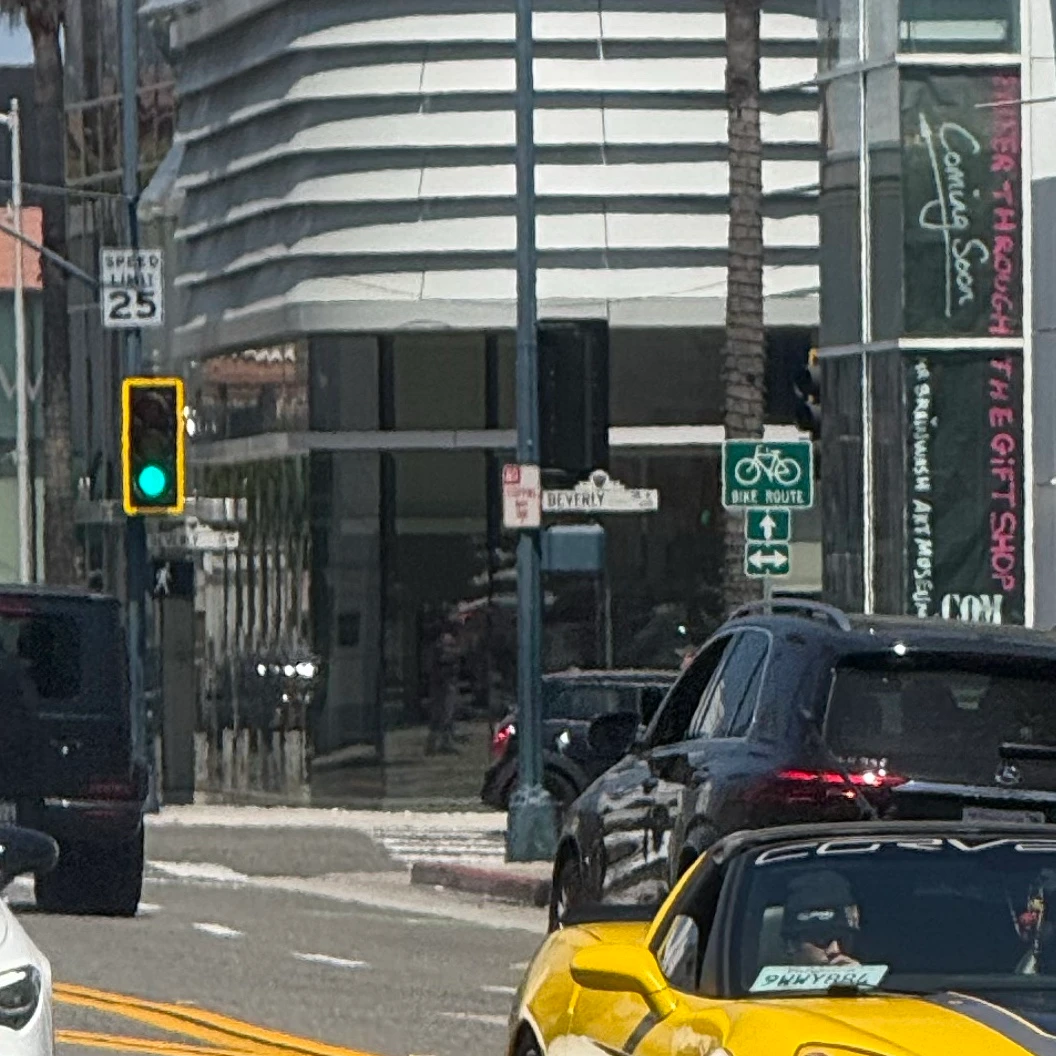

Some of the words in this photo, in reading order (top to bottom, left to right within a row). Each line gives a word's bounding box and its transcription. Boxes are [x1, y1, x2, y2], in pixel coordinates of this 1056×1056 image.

[919, 122, 981, 229] Coming
[952, 239, 989, 305] Soon
[105, 254, 158, 268] SPEED
[989, 180, 1017, 334] THROUGH
[111, 273, 153, 286] LIMIT
[109, 290, 156, 318] 25
[988, 358, 1013, 427] THE
[547, 492, 605, 508] BEVERLY
[731, 489, 758, 504] BIKE
[765, 489, 804, 504] ROUTE
[990, 512, 1017, 591] SHOP
